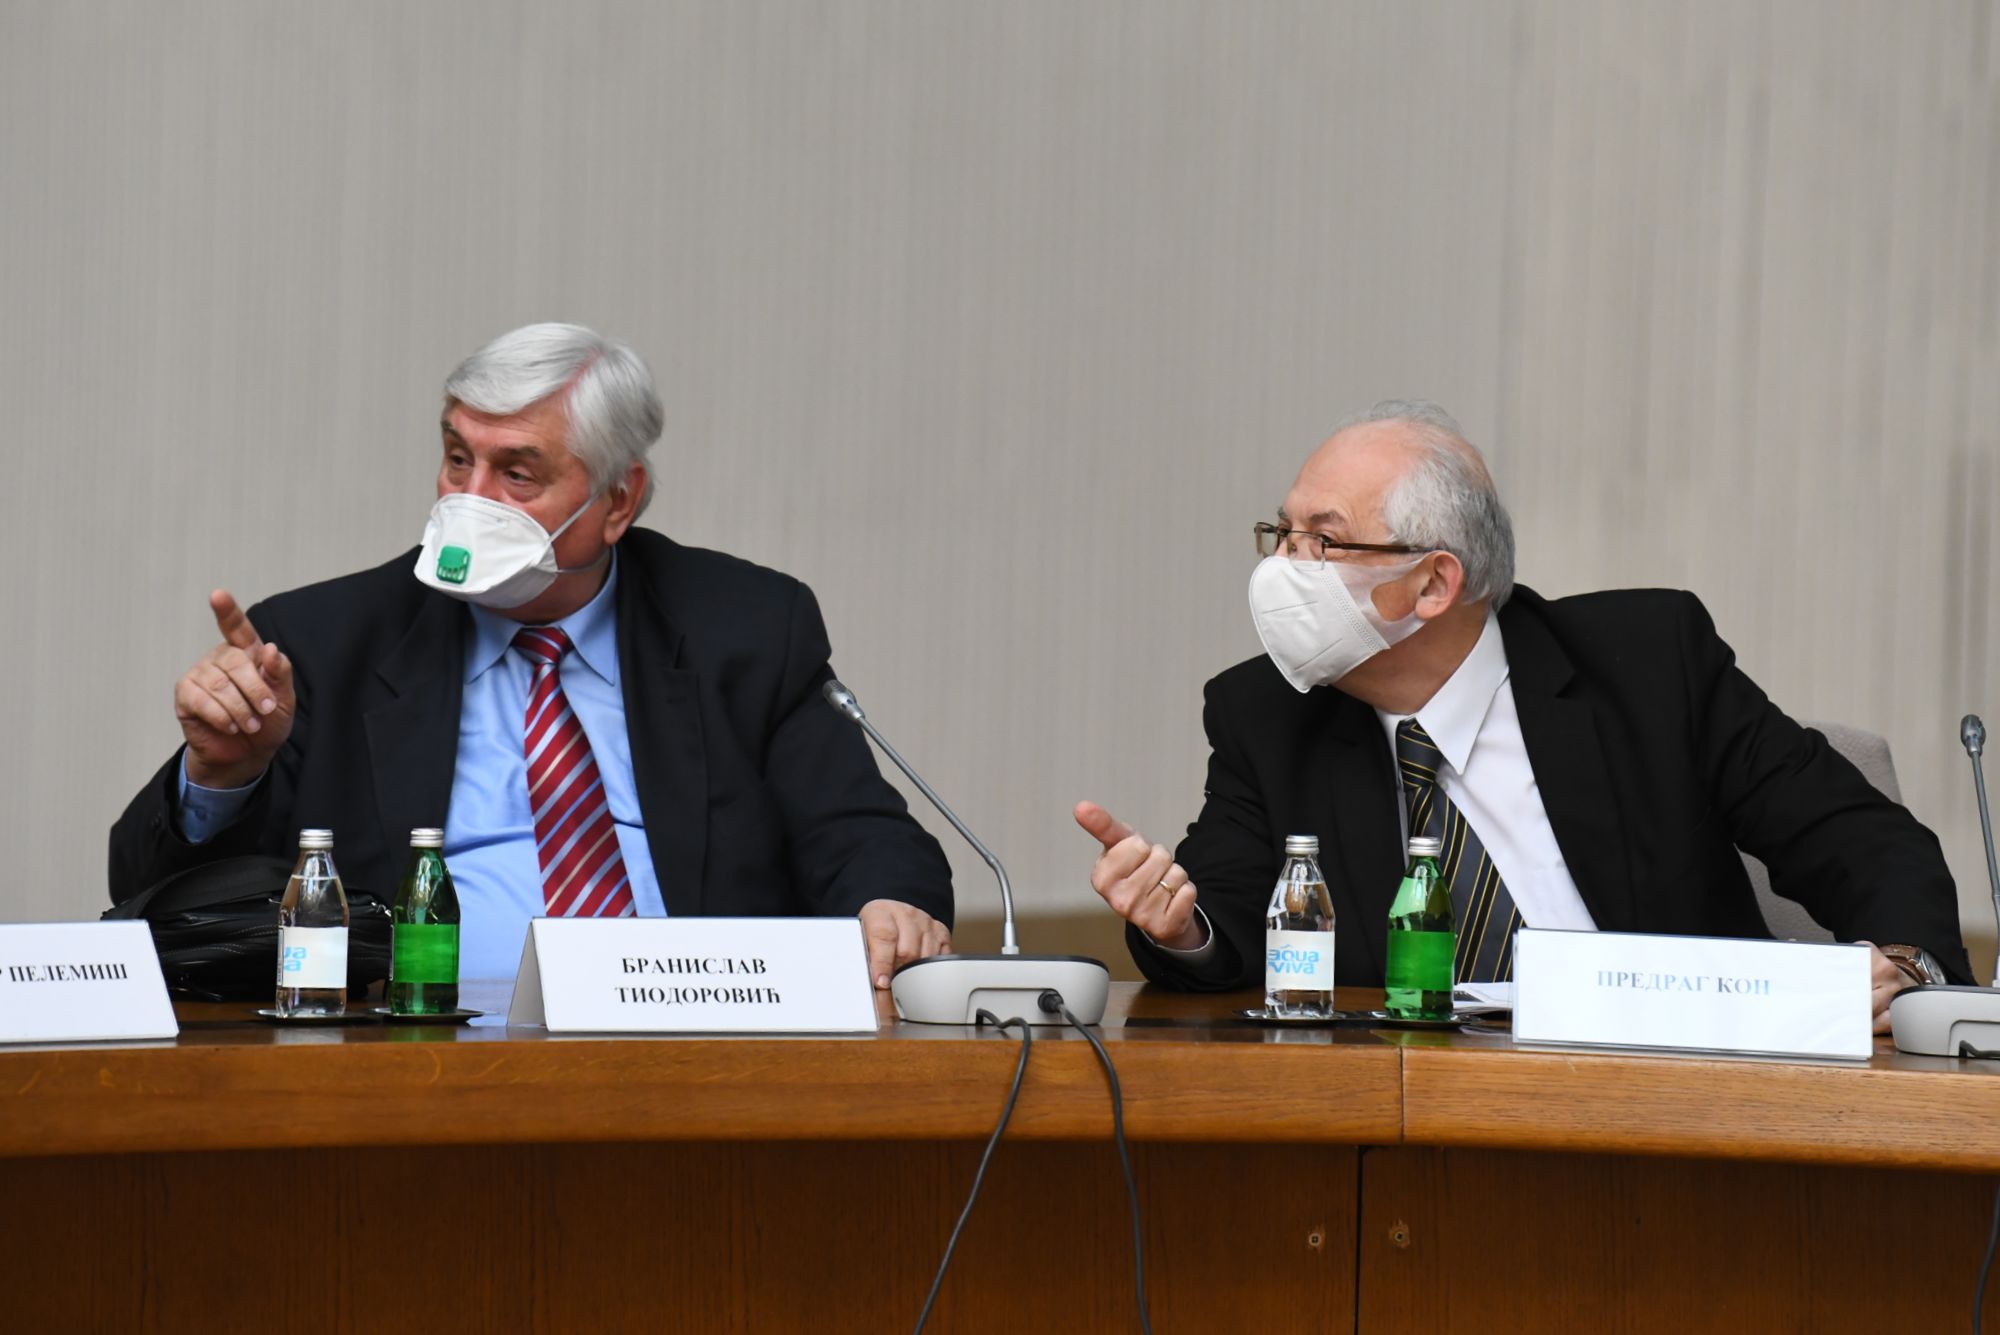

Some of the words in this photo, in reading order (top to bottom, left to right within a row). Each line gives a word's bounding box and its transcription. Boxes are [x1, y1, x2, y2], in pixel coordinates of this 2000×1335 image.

[9, 964, 127, 982] ПЕЛЕМИШ
[621, 957, 767, 974] БРАНИСЛАВ
[1268, 961, 1315, 974] viva
[1598, 970, 1710, 992] ПРЕДРАГ
[614, 986, 781, 1005] ТИОДОРОВИЋ
